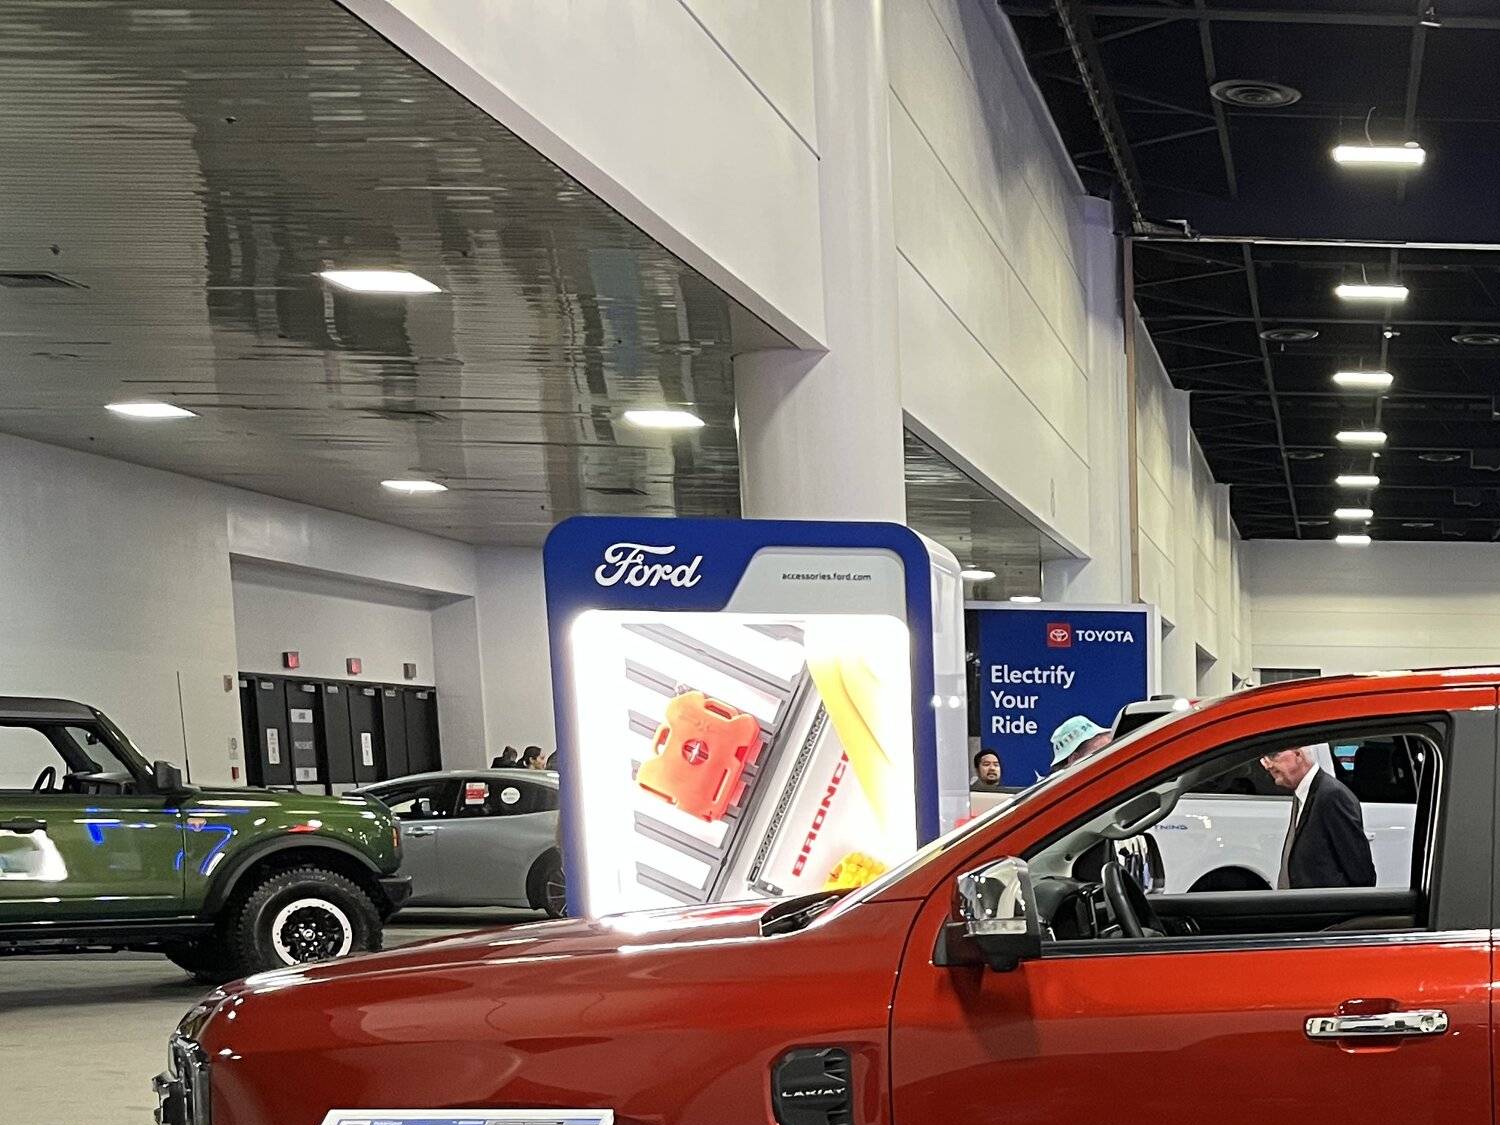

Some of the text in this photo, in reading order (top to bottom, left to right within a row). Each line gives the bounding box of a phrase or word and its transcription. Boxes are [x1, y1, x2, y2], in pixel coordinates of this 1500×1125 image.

[594, 542, 703, 588] Ford
[781, 572, 872, 582] accessories.ford.com
[1075, 629, 1134, 643] TOYOTA
[990, 664, 1076, 689] Electrify
[990, 690, 1039, 709] Your
[991, 714, 1038, 734] Ride
[781, 1087, 846, 1098] LARIAT
